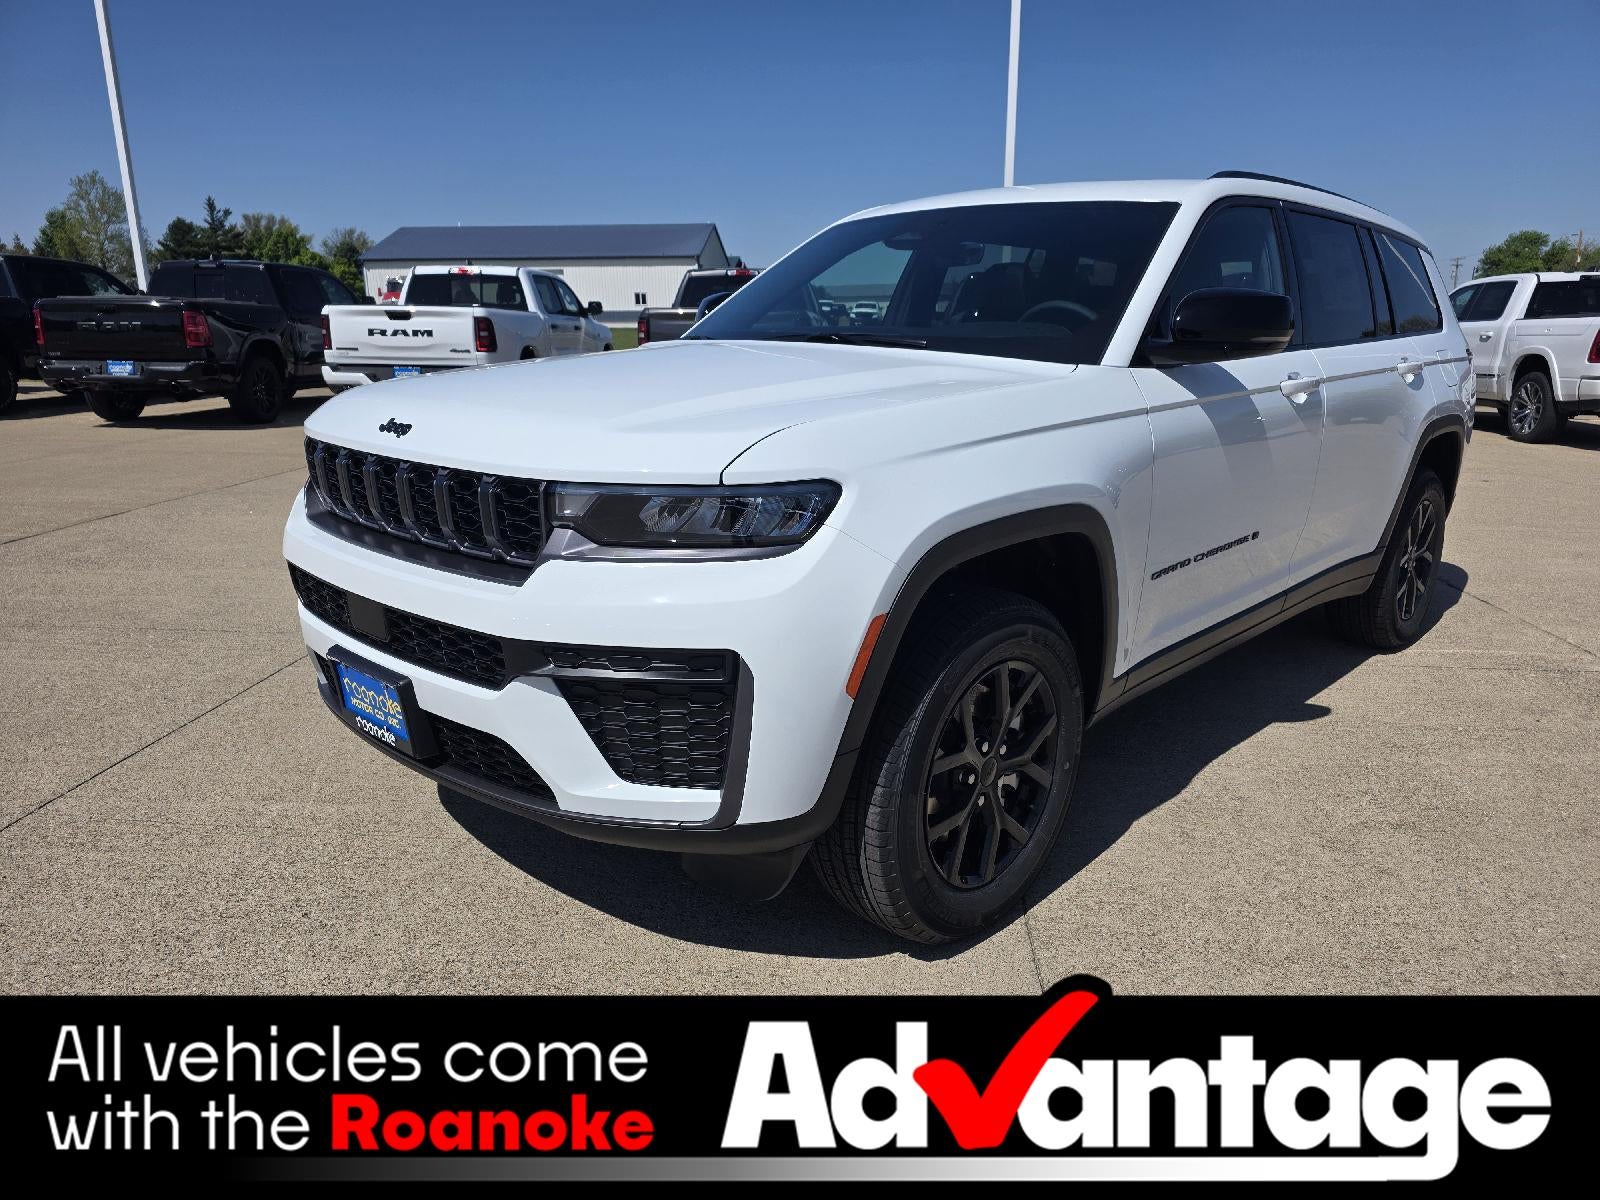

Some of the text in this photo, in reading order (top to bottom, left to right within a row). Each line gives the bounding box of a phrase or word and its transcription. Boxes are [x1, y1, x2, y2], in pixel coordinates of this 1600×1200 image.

[368, 328, 433, 337] RAM
[1151, 534, 1251, 581] GRAND CHEROKEE
[351, 696, 374, 714] MOTOR
[356, 715, 396, 746] roanoke
